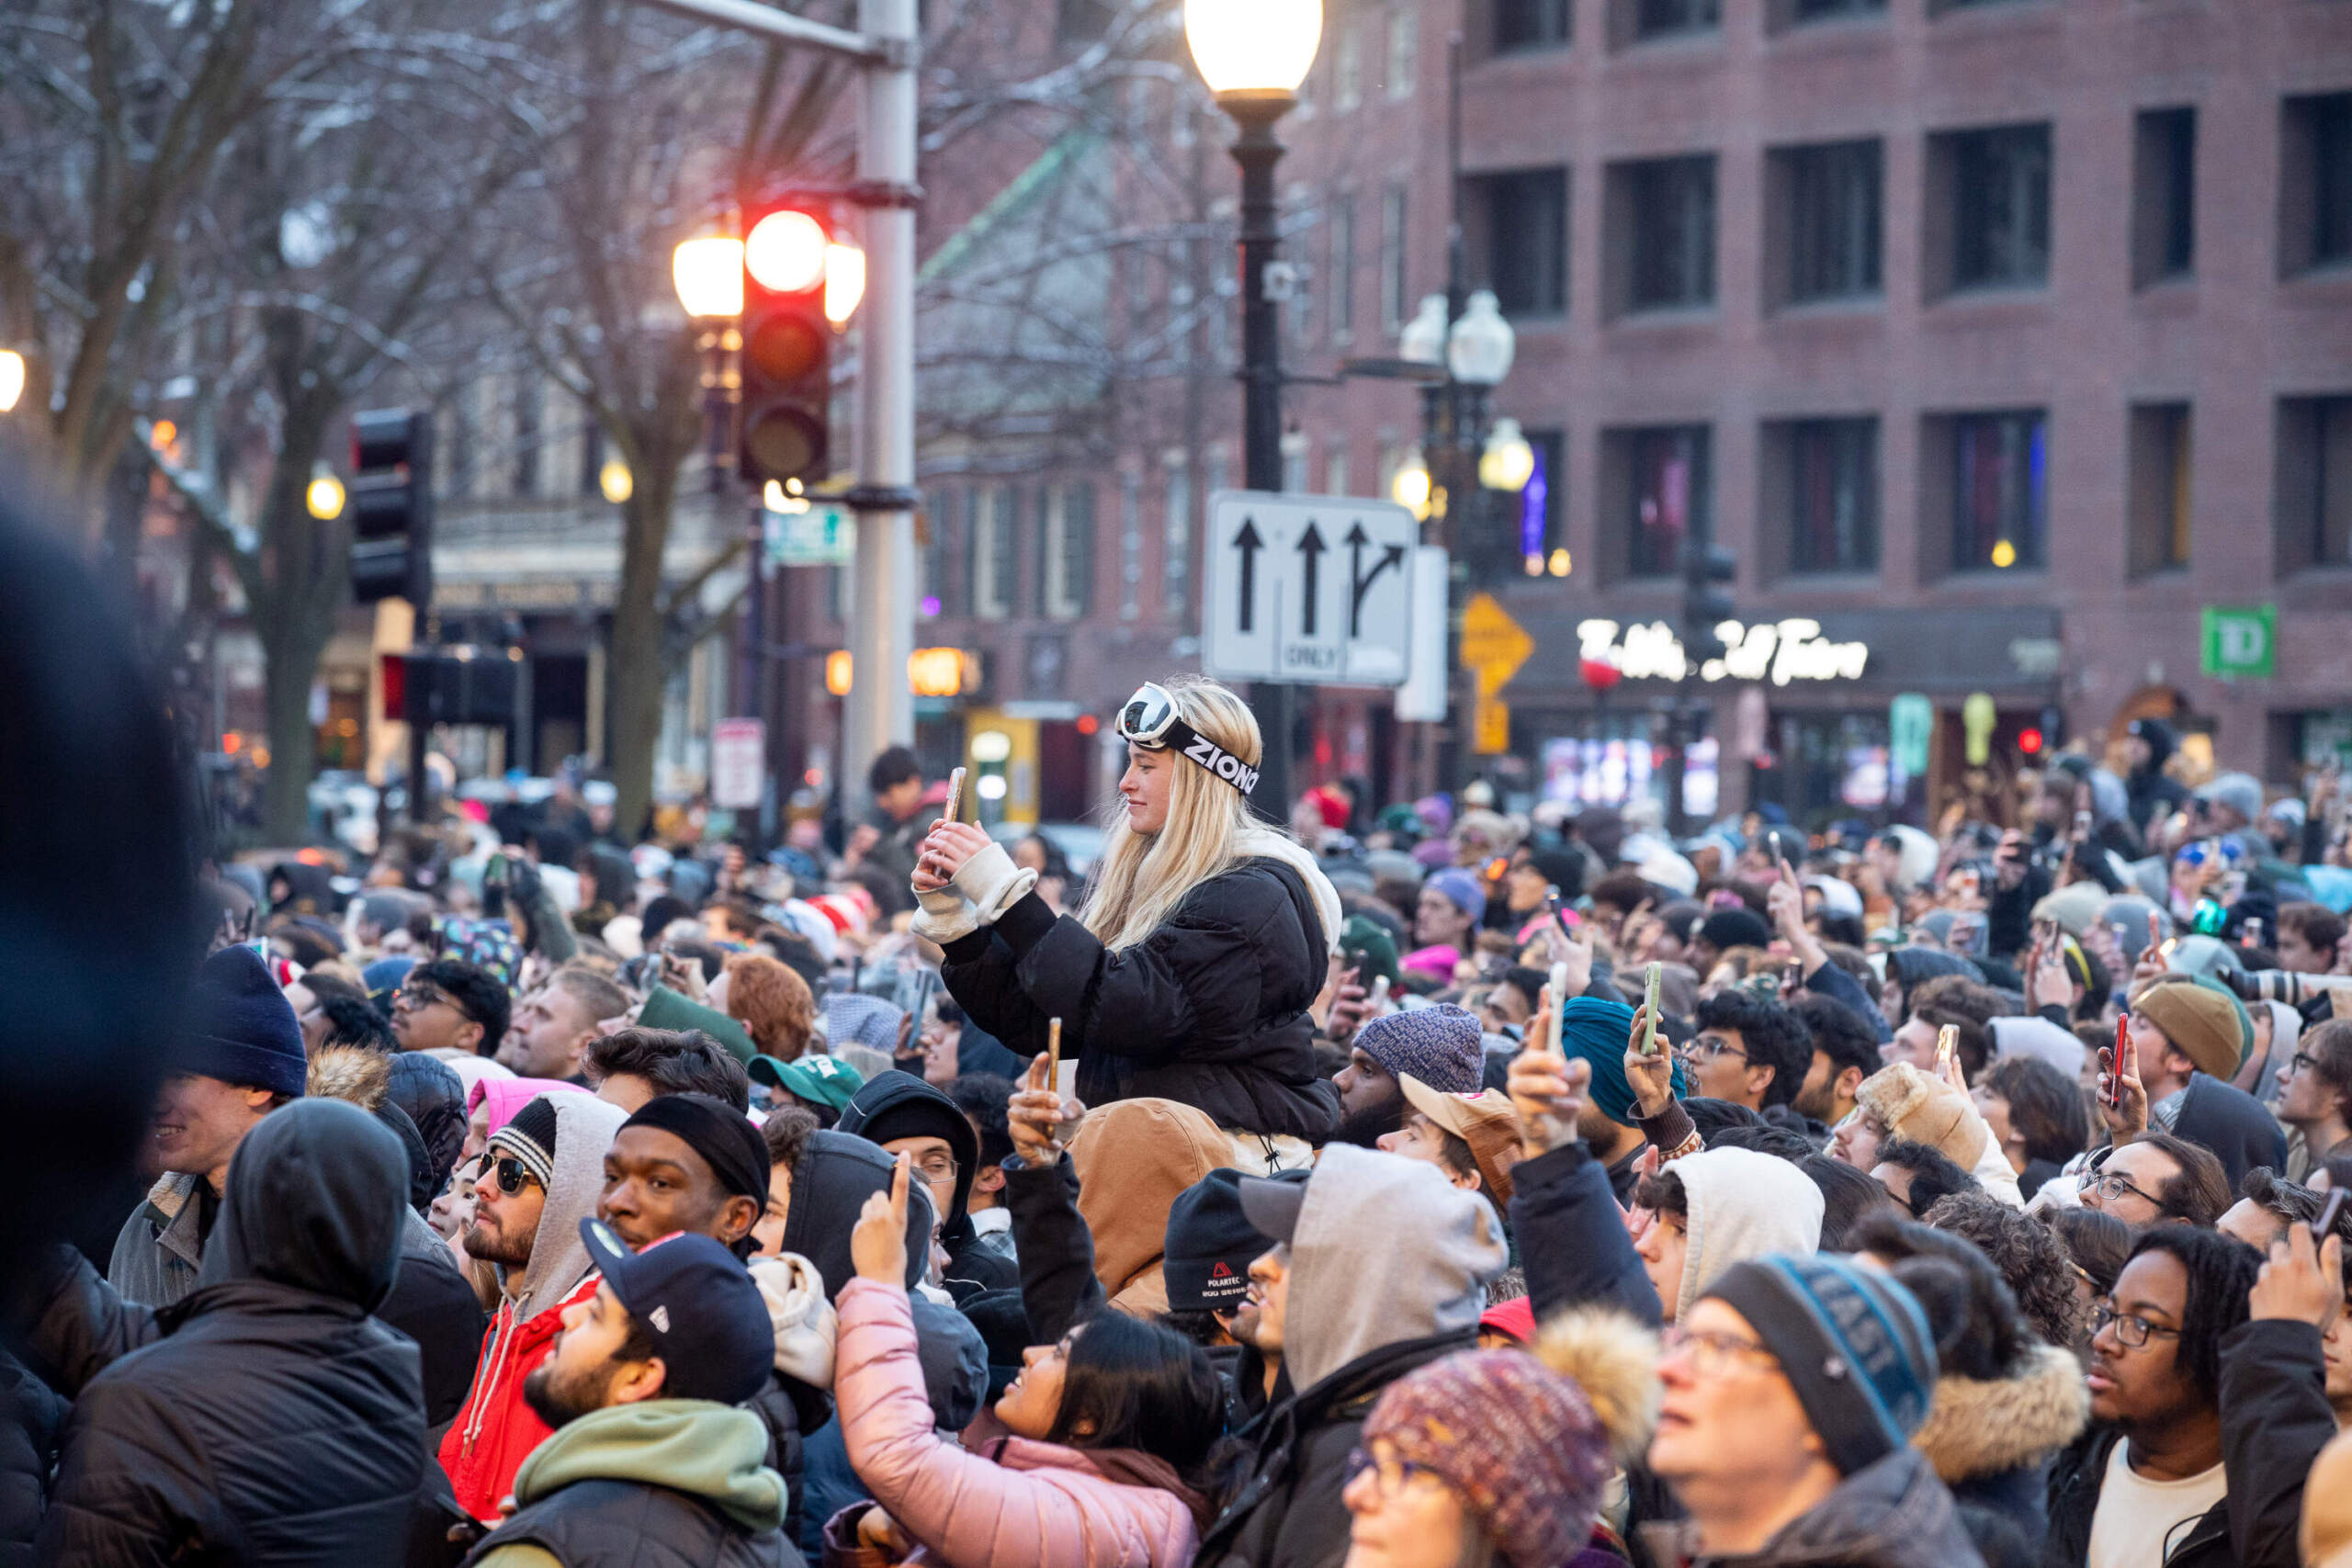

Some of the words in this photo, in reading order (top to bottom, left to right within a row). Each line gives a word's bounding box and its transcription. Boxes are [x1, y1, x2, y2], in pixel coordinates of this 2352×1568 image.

[2219, 617, 2264, 664] TD
[1287, 646, 1337, 668] ONLY
[1207, 1277, 1240, 1287] POLARTEC
